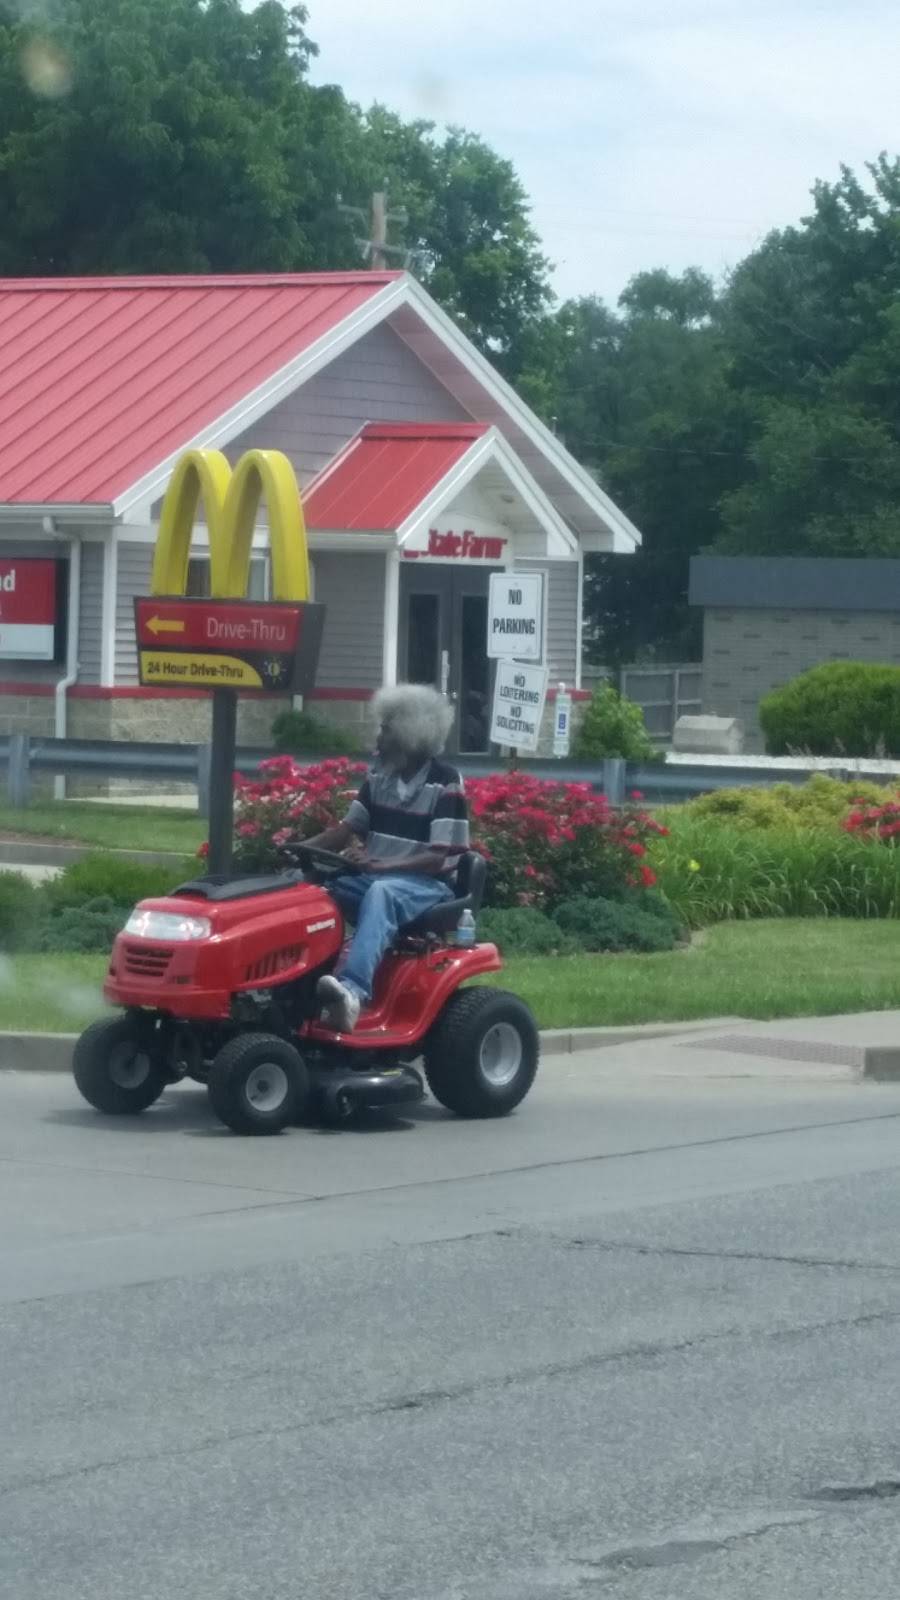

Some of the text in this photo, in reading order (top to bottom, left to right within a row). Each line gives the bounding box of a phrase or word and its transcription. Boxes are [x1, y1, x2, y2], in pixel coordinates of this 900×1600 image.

[152, 449, 310, 601] M
[508, 589, 522, 605] NO
[206, 617, 286, 640] Drive-Thru
[493, 618, 536, 635] PARKING
[147, 662, 244, 678] 24 Hour Drive-Thru
[514, 675, 525, 688] NO
[500, 684, 539, 704] LOITERING
[510, 706, 522, 718] NO
[496, 715, 535, 735] SOLICITING
